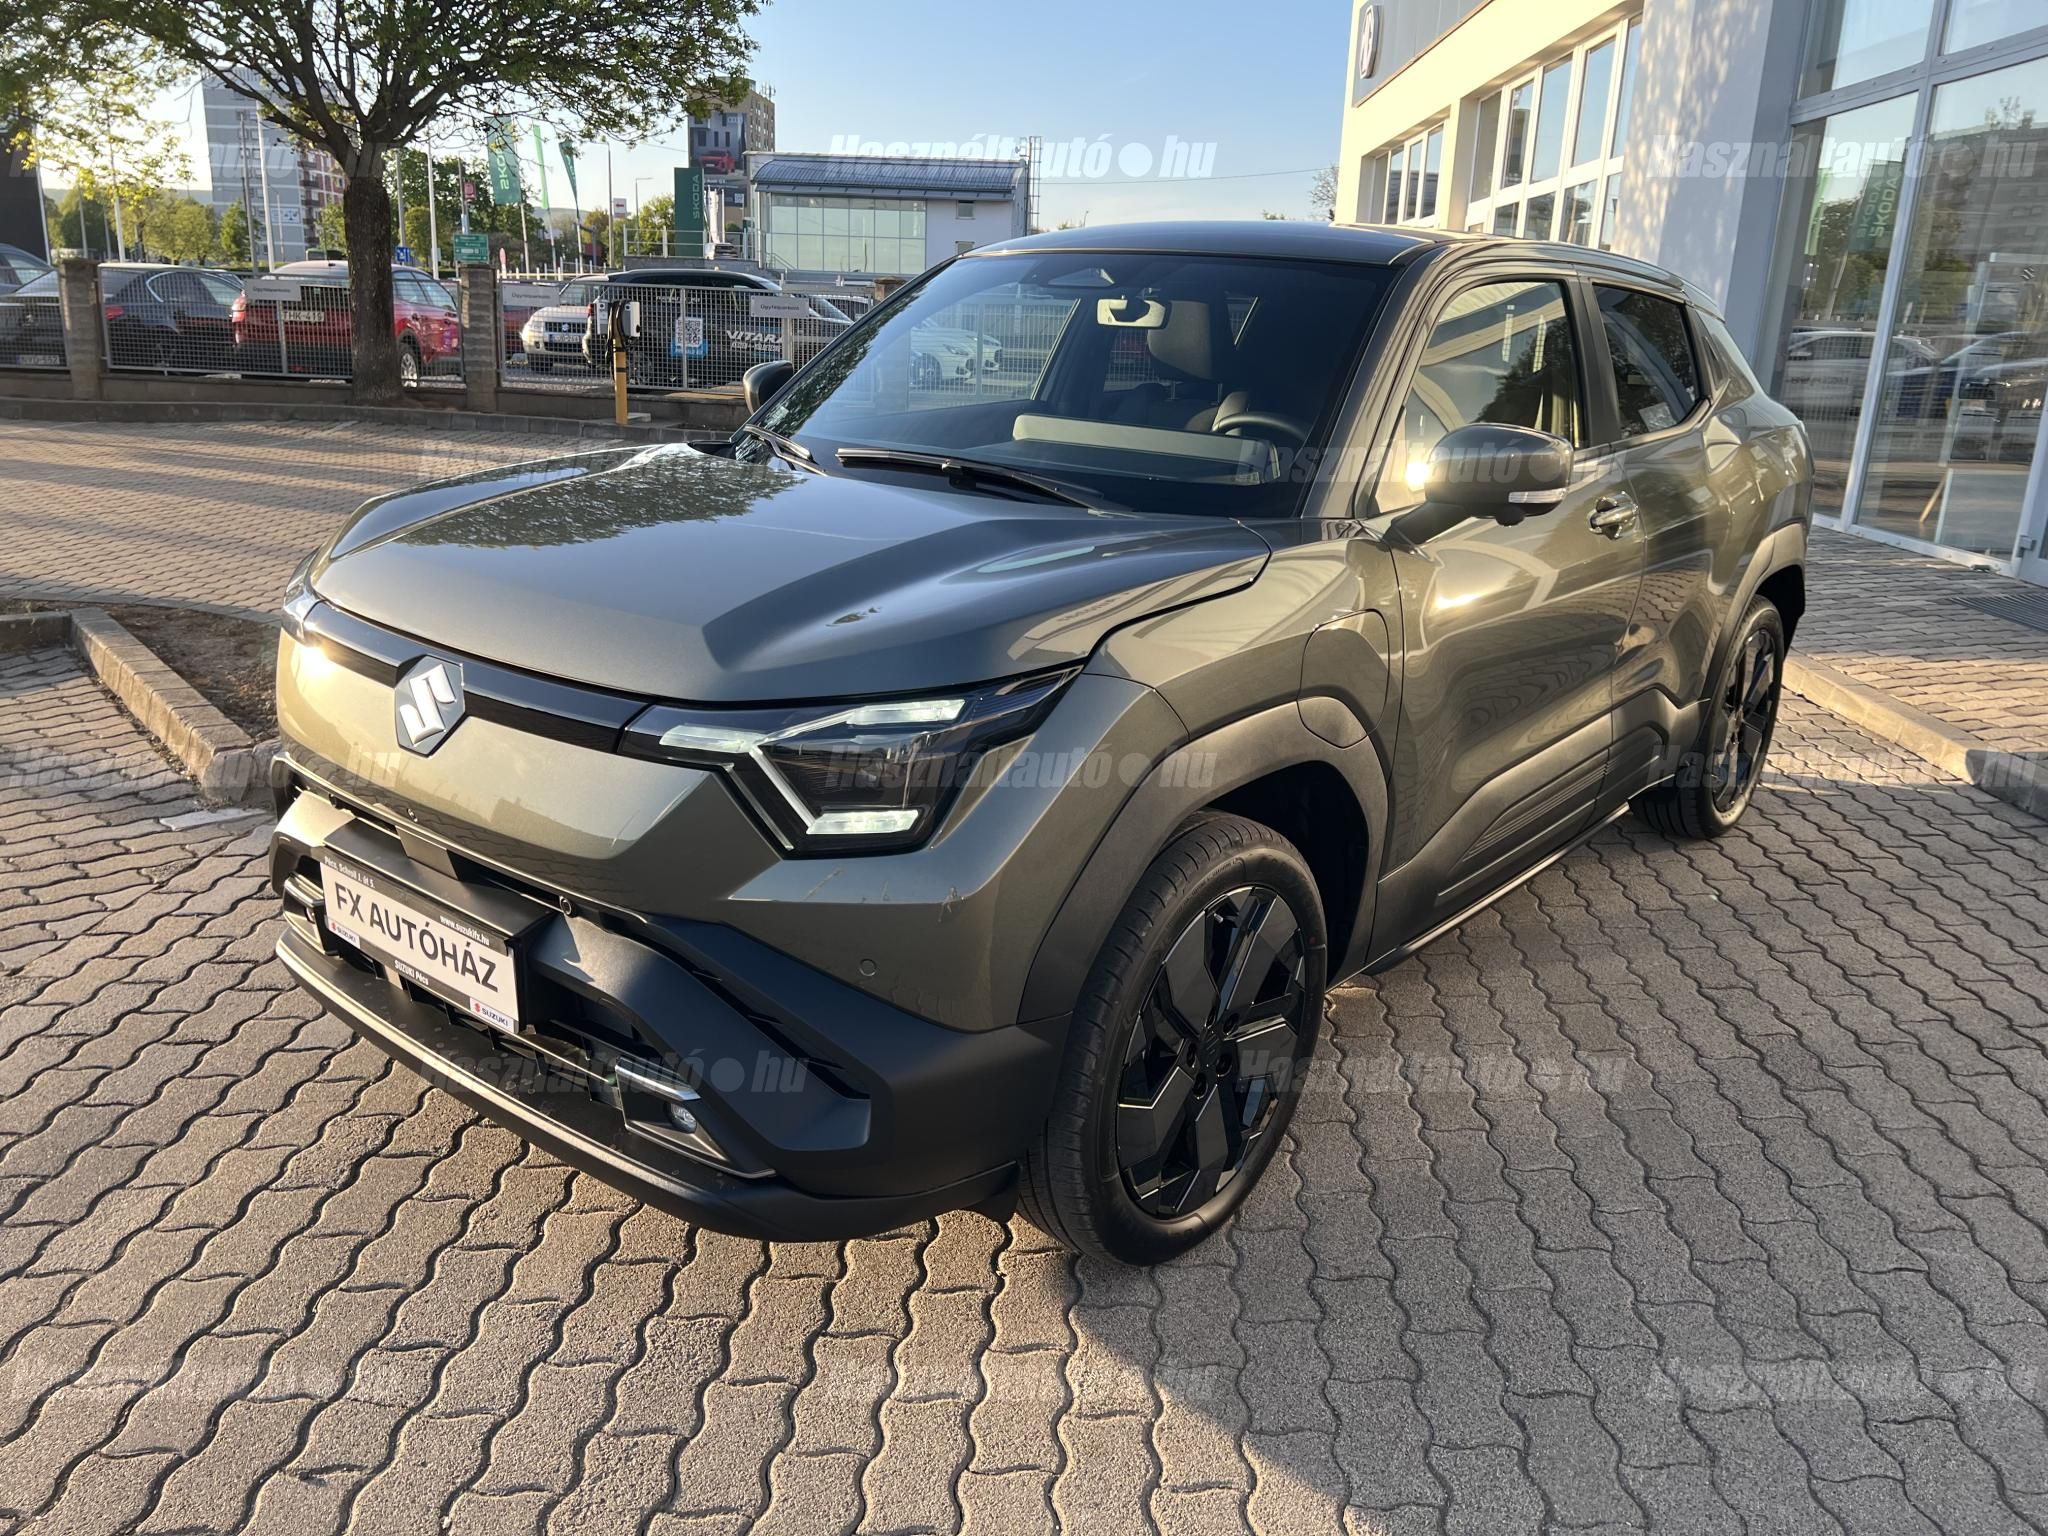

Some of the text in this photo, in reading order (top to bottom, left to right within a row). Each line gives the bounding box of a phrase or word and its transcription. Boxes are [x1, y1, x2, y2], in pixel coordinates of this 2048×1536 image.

[334, 881, 499, 993] FX AUTÓHÁZ
[394, 959, 415, 980] SUZUKI
[481, 1007, 509, 1027] SUZUKI
